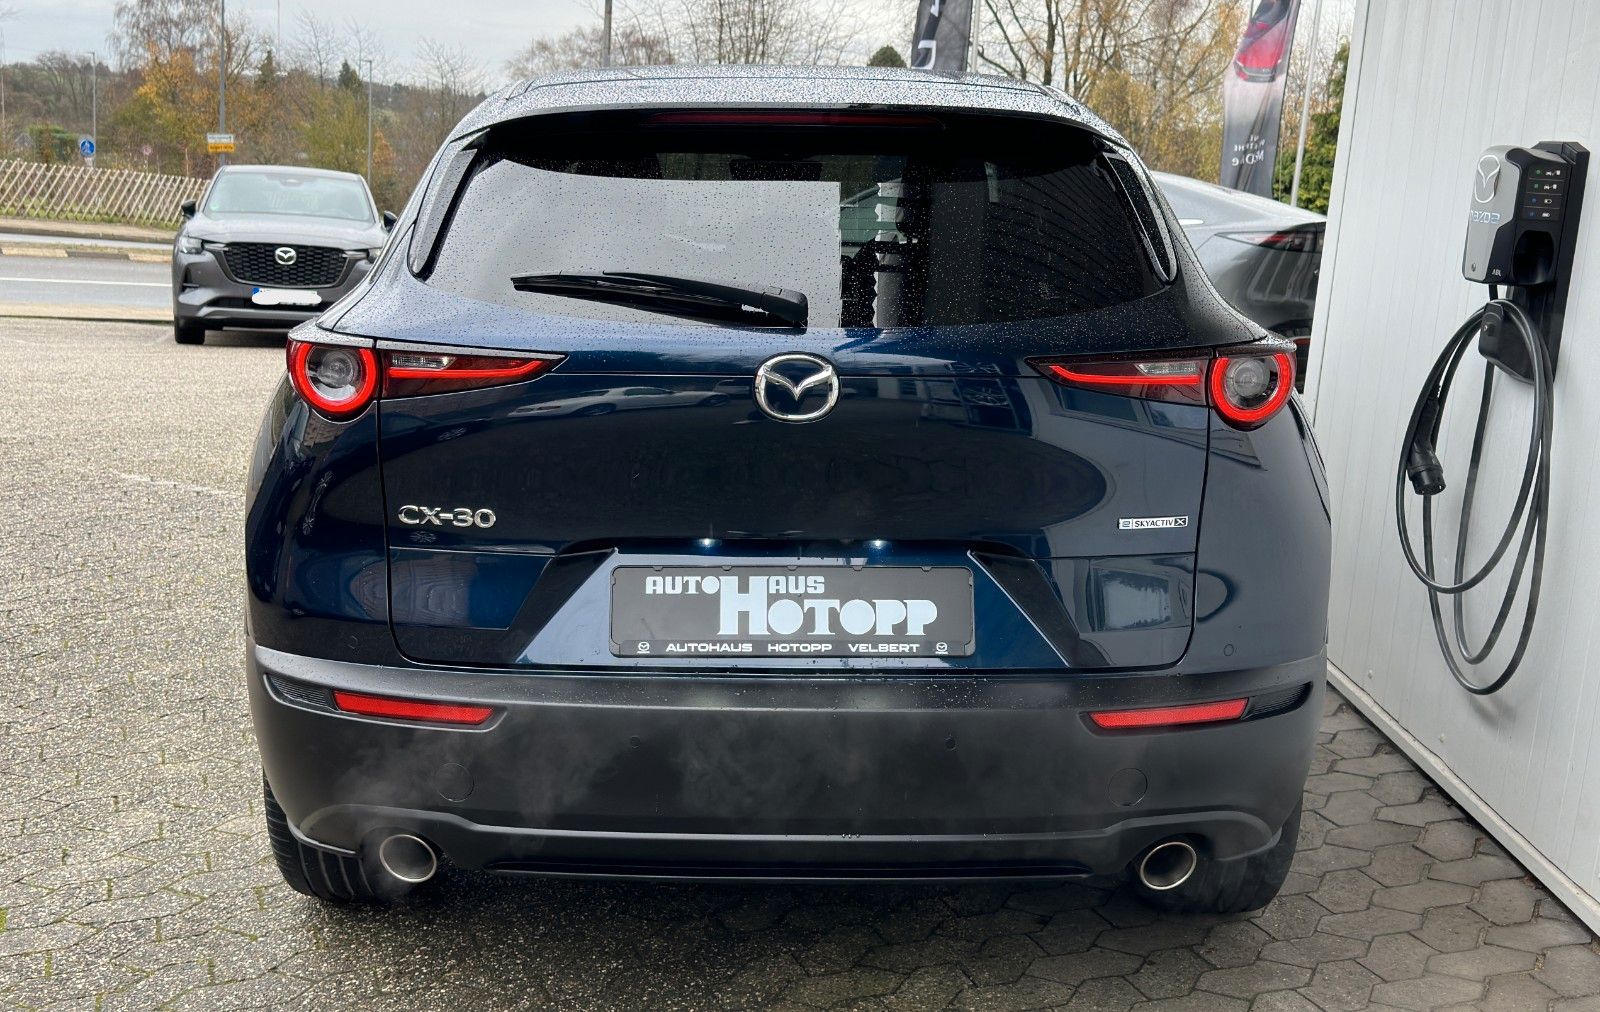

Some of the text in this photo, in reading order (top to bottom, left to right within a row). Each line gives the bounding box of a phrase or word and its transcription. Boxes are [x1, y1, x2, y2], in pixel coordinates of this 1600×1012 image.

[398, 505, 496, 528] CX-30
[665, 642, 921, 653] AUTOHAUS HOTOPP VELBERT
